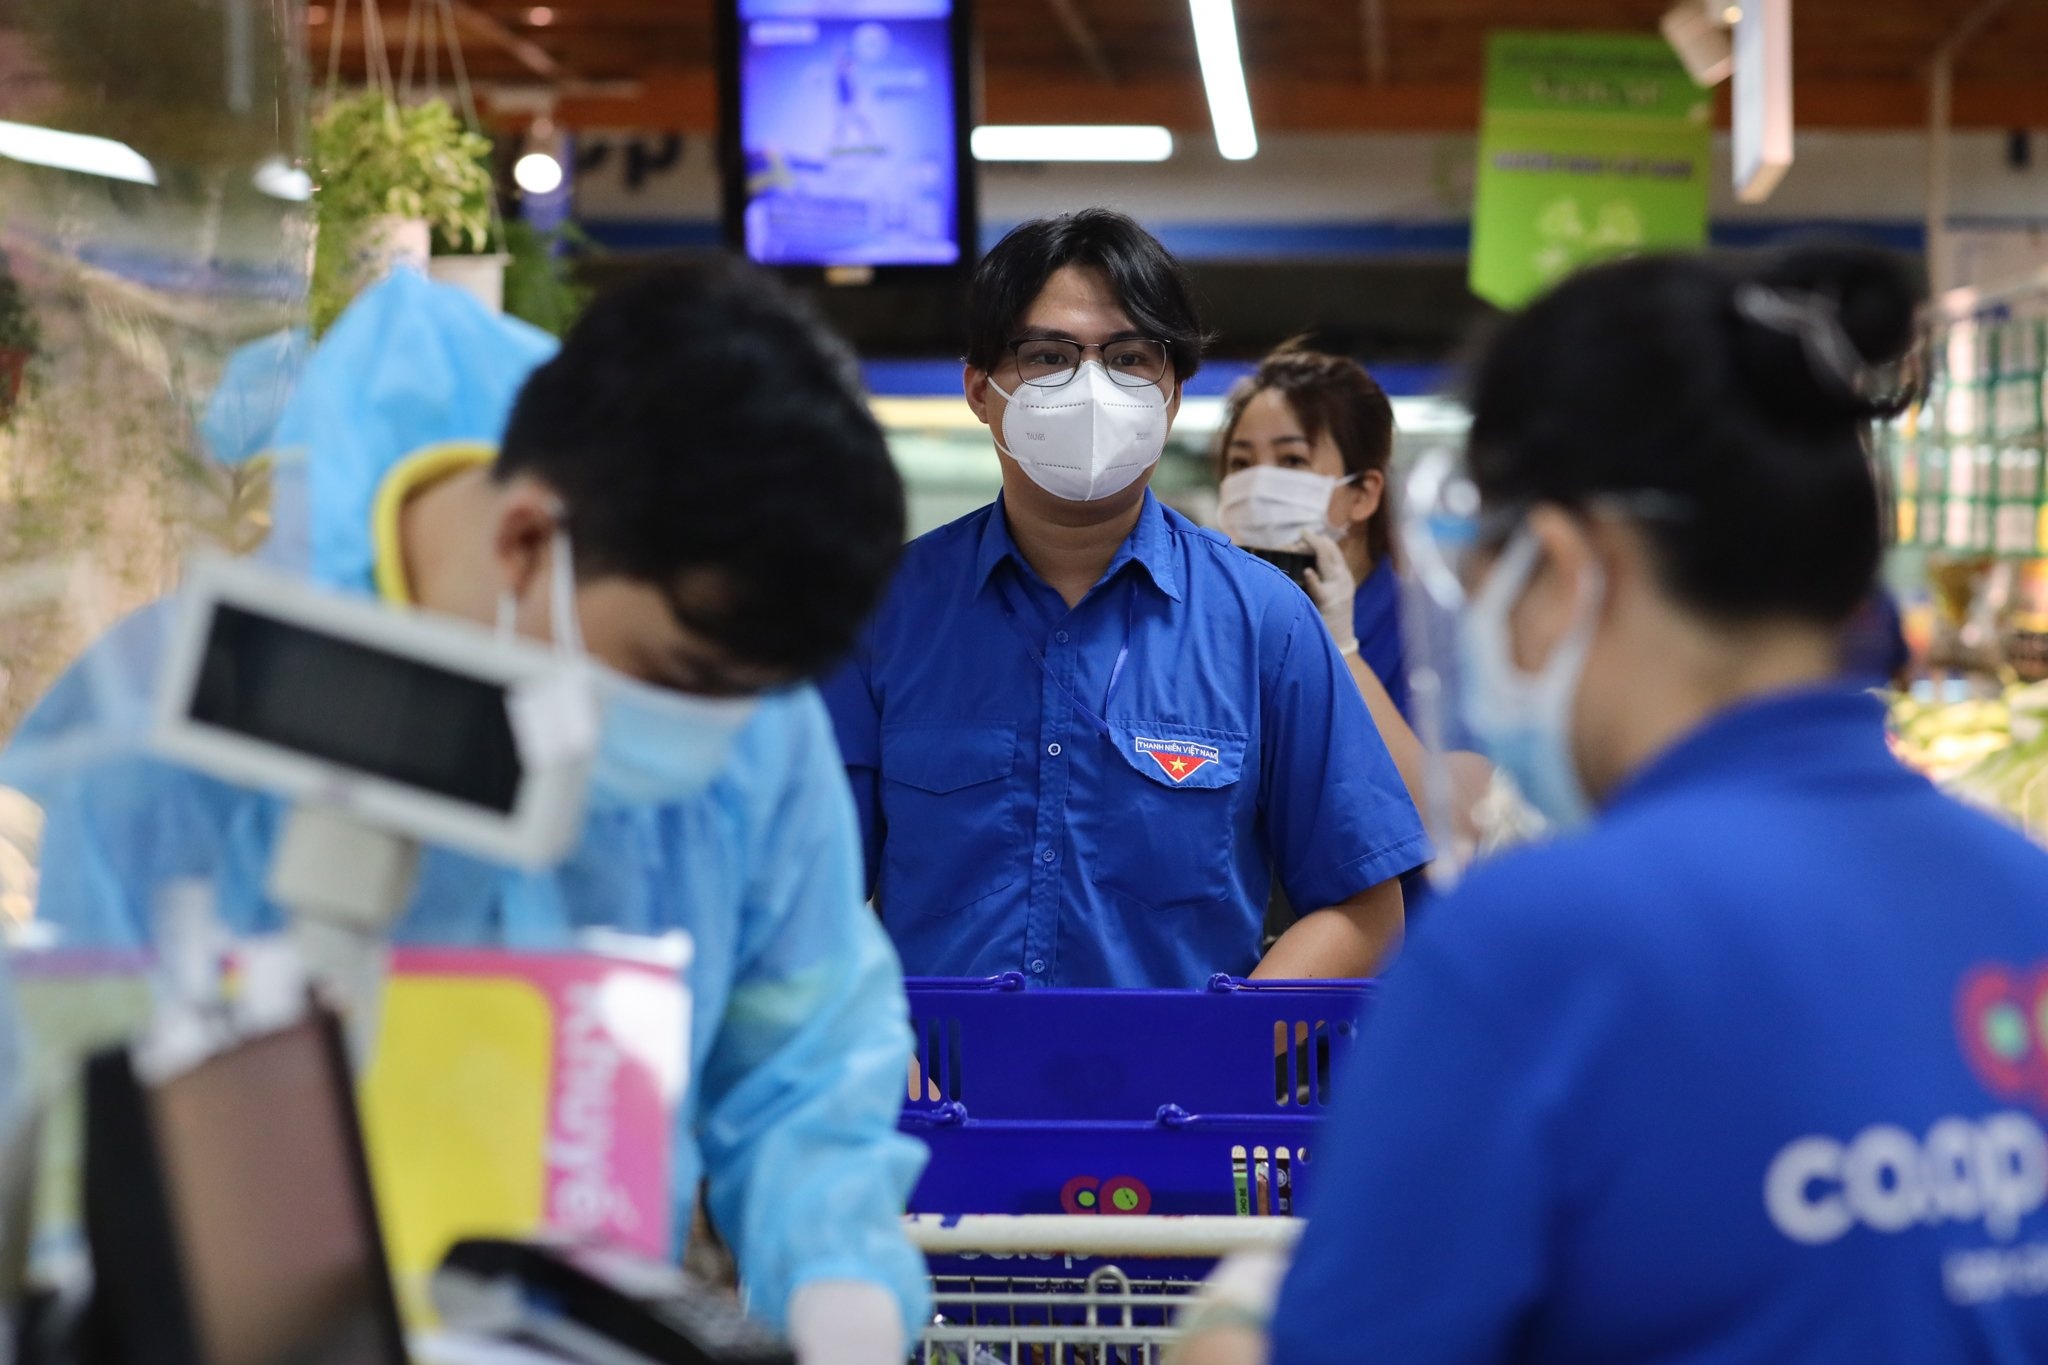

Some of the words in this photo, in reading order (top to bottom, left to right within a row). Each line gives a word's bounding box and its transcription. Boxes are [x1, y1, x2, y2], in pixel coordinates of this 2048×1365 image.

[1138, 741, 1164, 751] THANH
[1165, 743, 1181, 752] NIÊN
[1183, 745, 1199, 756] VIỆT
[1200, 749, 1217, 759] NAM
